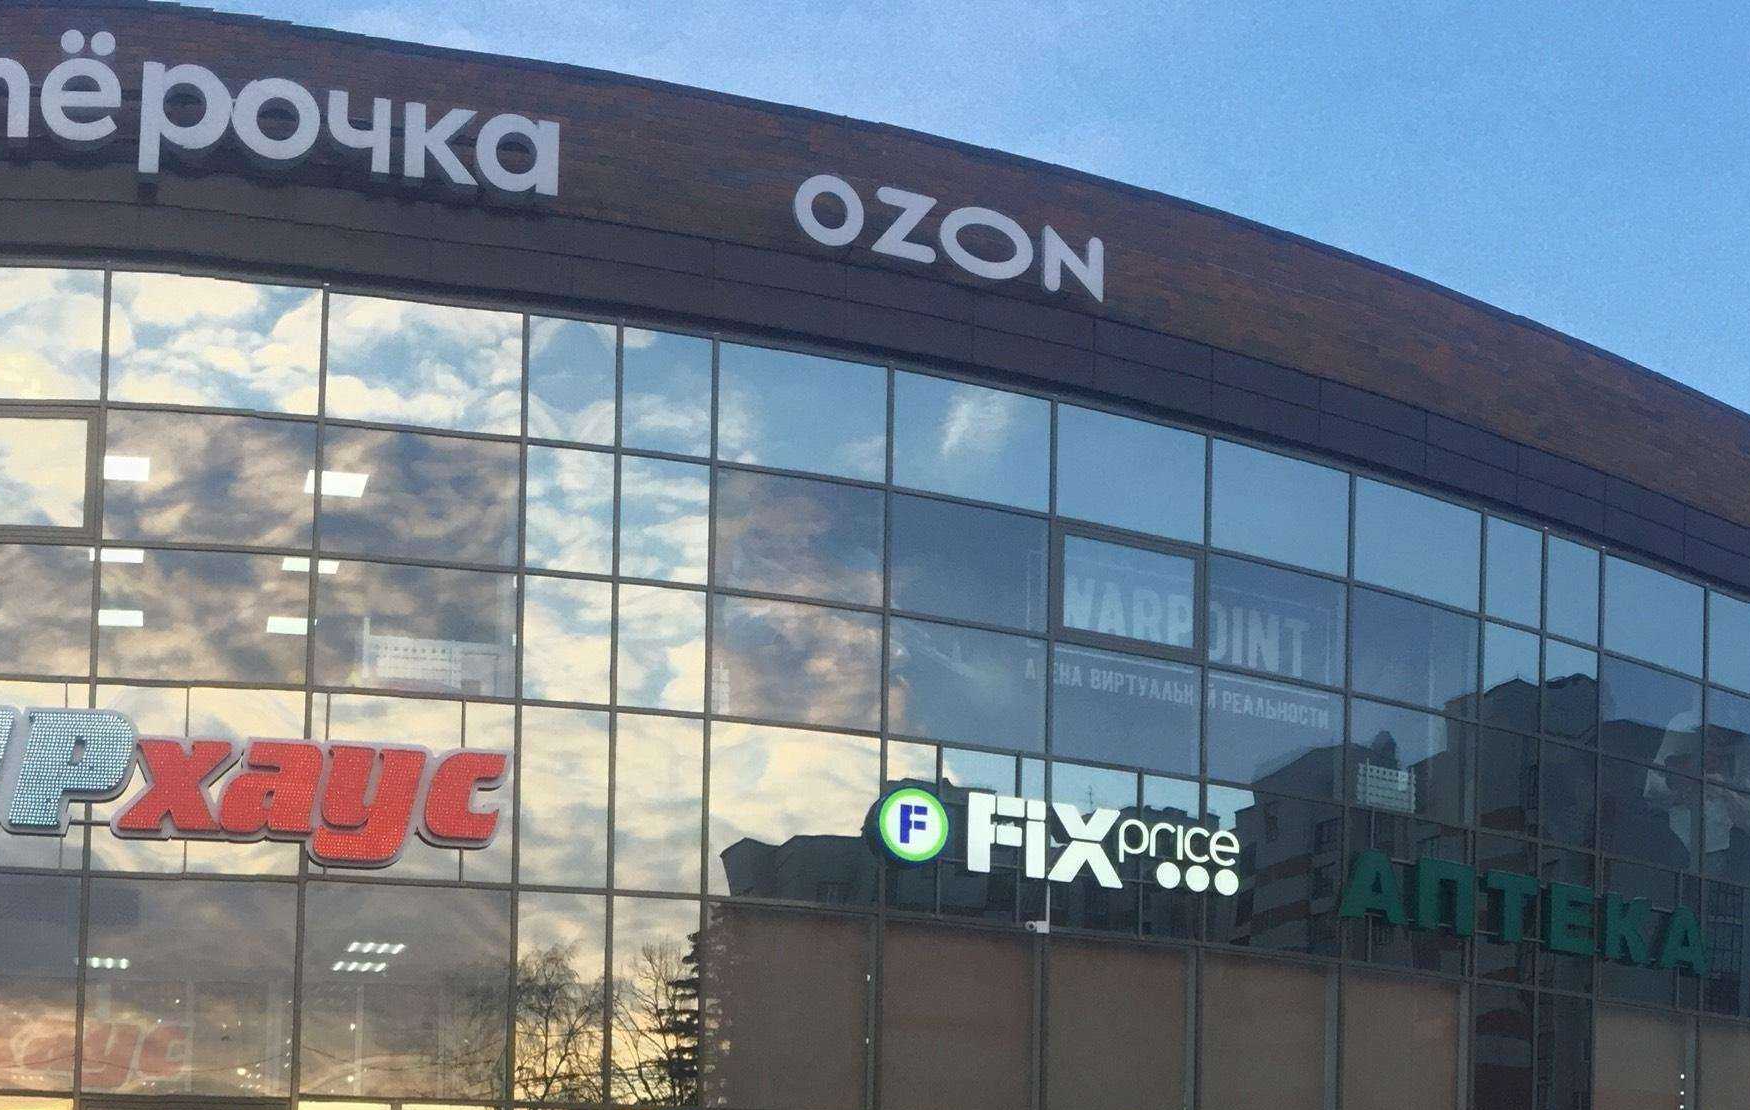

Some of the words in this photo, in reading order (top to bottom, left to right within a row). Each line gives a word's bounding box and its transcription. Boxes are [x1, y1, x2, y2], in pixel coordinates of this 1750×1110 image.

[794, 172, 1104, 303] OZON
[1025, 657, 1083, 688] АЕНА
[1090, 668, 1216, 709] ВИРТУАЛЬНЙ
[1222, 690, 1329, 729] РЕАЛЬНОСТИ
[900, 803, 927, 844] F
[1118, 815, 1240, 869] price
[1340, 850, 1712, 976] АПТЕКА
